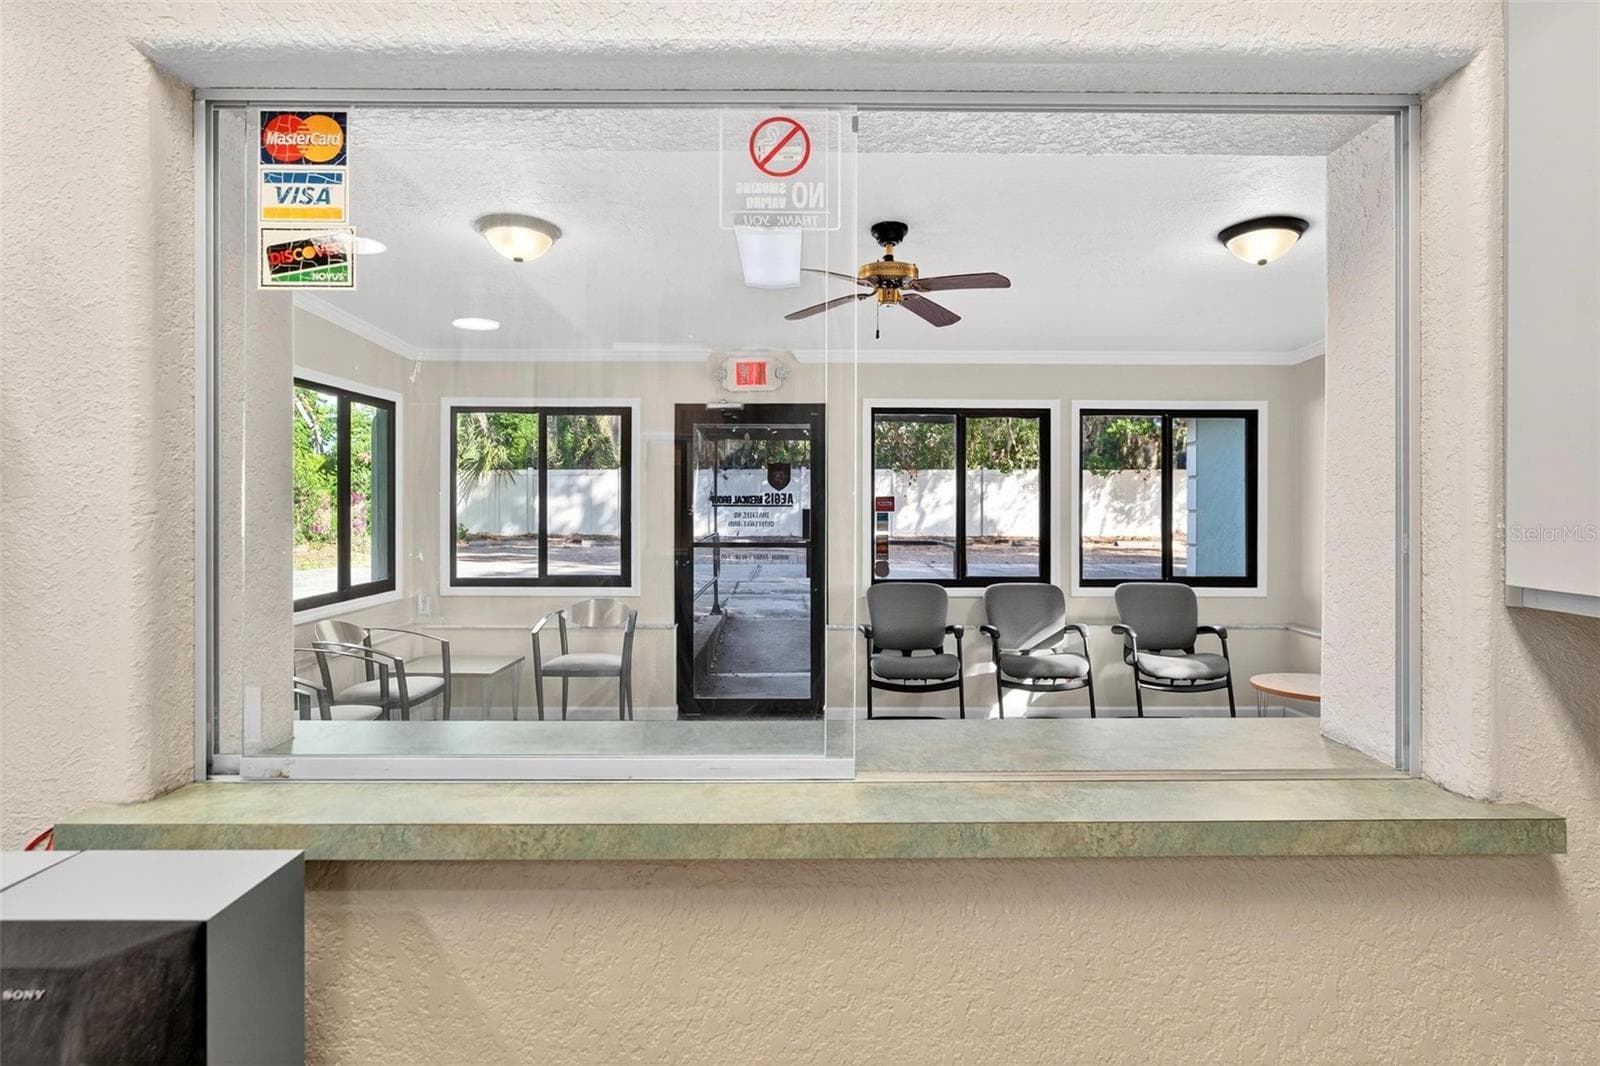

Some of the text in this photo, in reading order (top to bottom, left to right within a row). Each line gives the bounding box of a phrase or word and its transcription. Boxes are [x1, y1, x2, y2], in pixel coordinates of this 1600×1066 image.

[266, 130, 341, 146] MasterCard
[275, 186, 331, 205] VISA
[312, 272, 345, 281] NOVUS
[2, 989, 46, 1001] SONY
